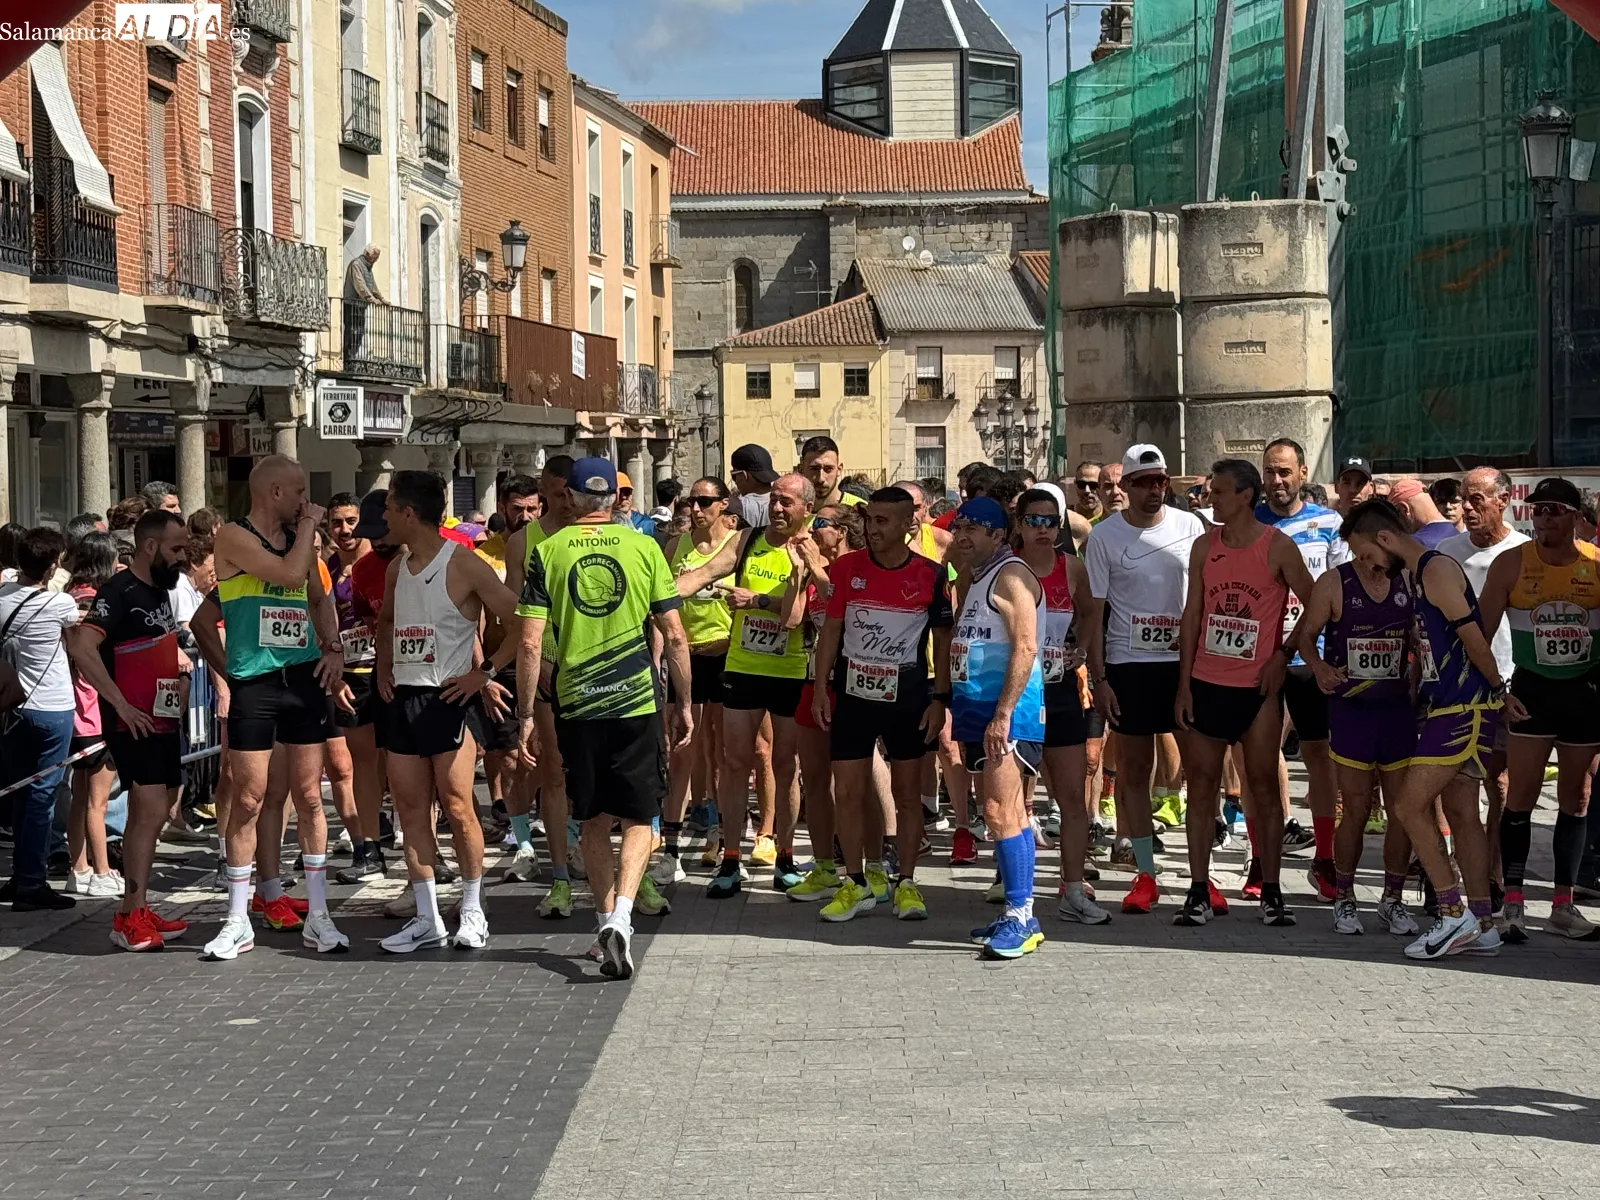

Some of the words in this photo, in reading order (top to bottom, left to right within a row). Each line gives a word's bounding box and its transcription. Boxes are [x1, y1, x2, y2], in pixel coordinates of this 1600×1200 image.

[323, 425, 357, 436] CARRERA
[567, 536, 621, 549] ANTONIO
[271, 621, 302, 638] 843
[395, 626, 434, 638] bedunia
[1208, 616, 1258, 633] bedunia
[749, 628, 779, 646] 727
[1141, 627, 1173, 643] 825
[1215, 630, 1245, 648] 716
[400, 638, 427, 655] 837
[1546, 639, 1582, 656] 830
[849, 660, 898, 677] bedunia
[1358, 653, 1392, 669] 800
[856, 674, 887, 691] 854
